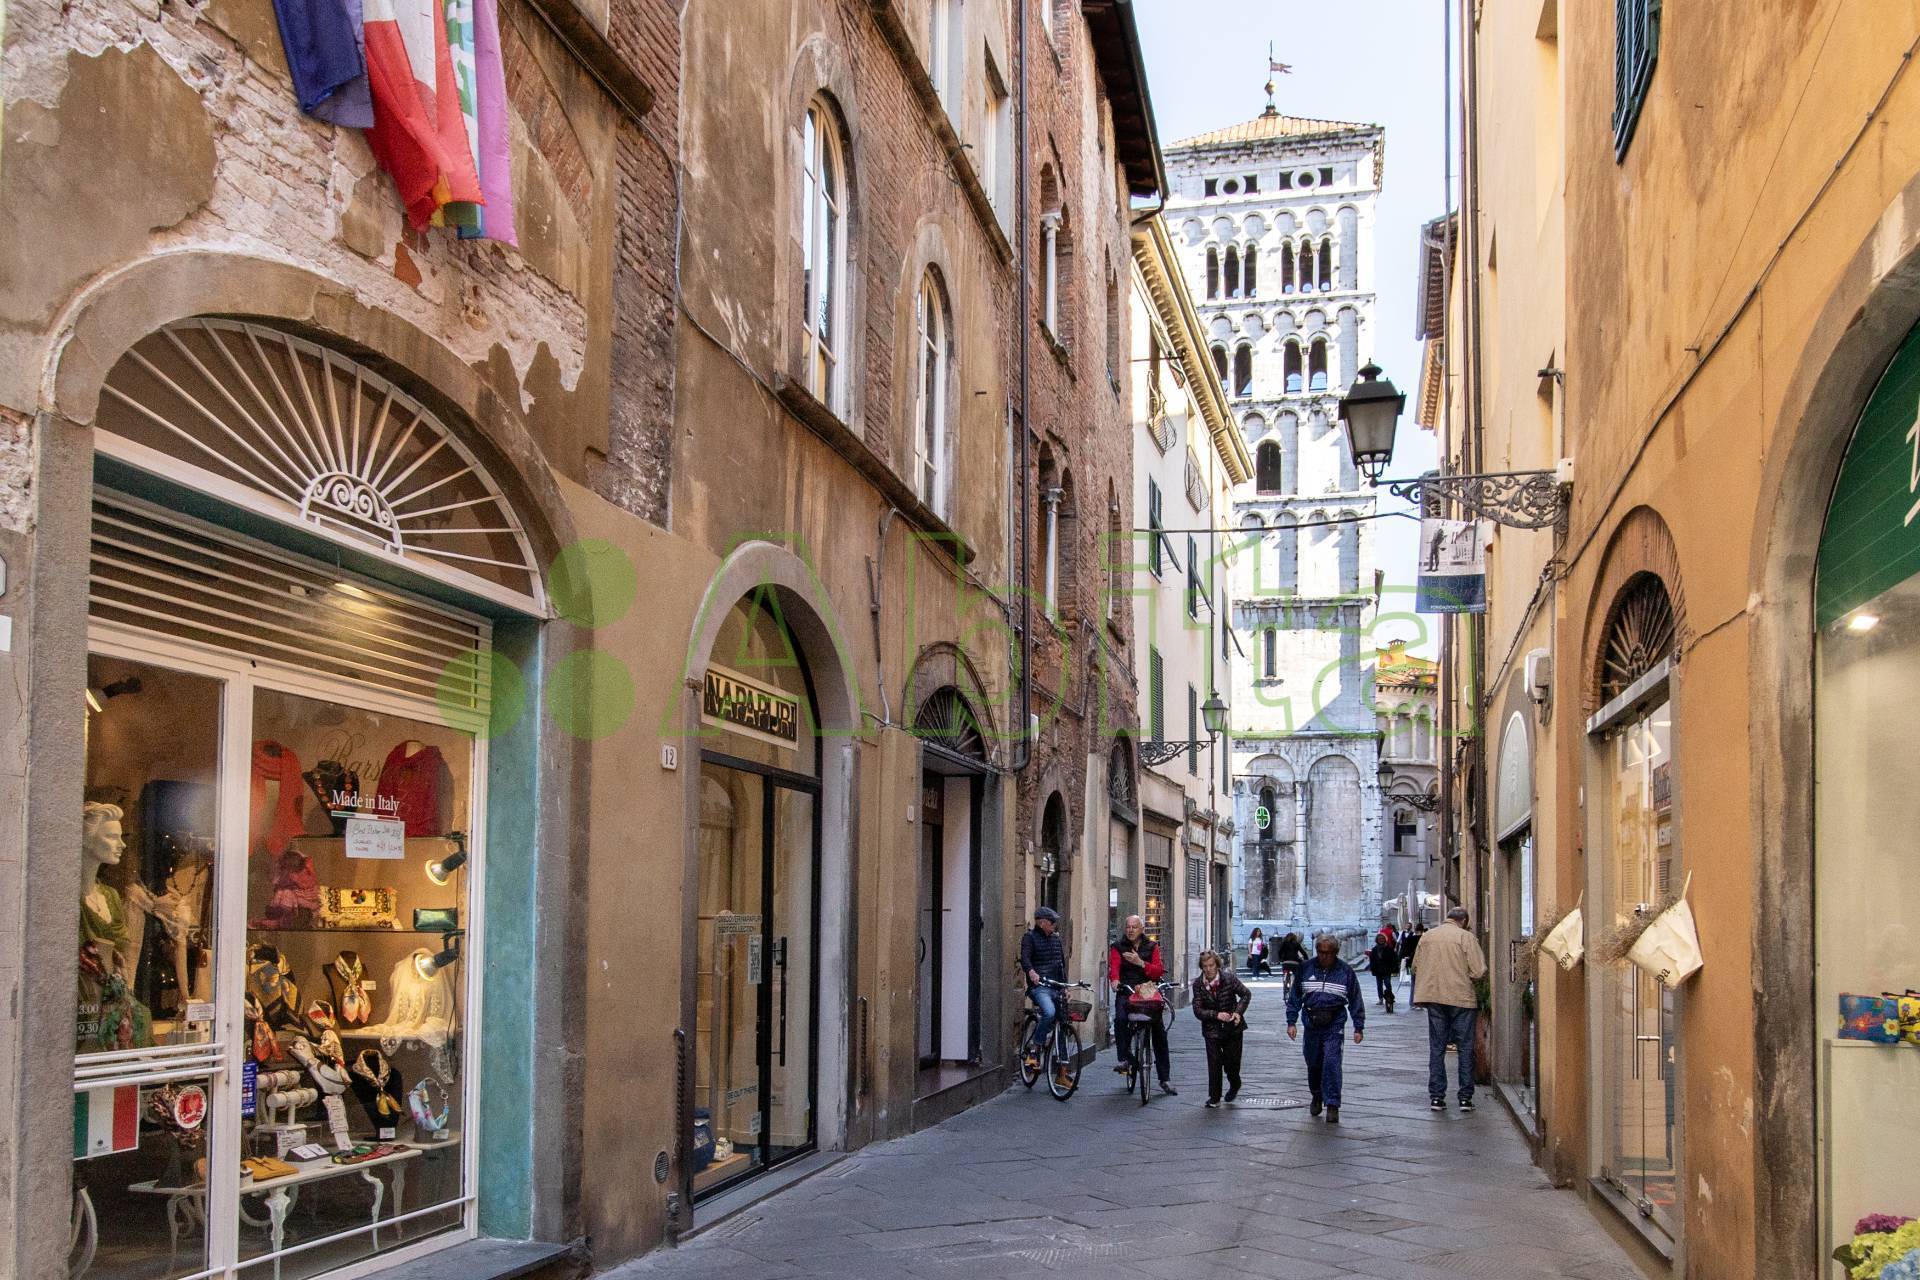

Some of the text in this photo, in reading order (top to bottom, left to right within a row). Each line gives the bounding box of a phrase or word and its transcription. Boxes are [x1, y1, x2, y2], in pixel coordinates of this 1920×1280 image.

[704, 672, 796, 738] NAPAPIJRI
[665, 748, 675, 766] 12
[332, 789, 400, 816] Made in Italy
